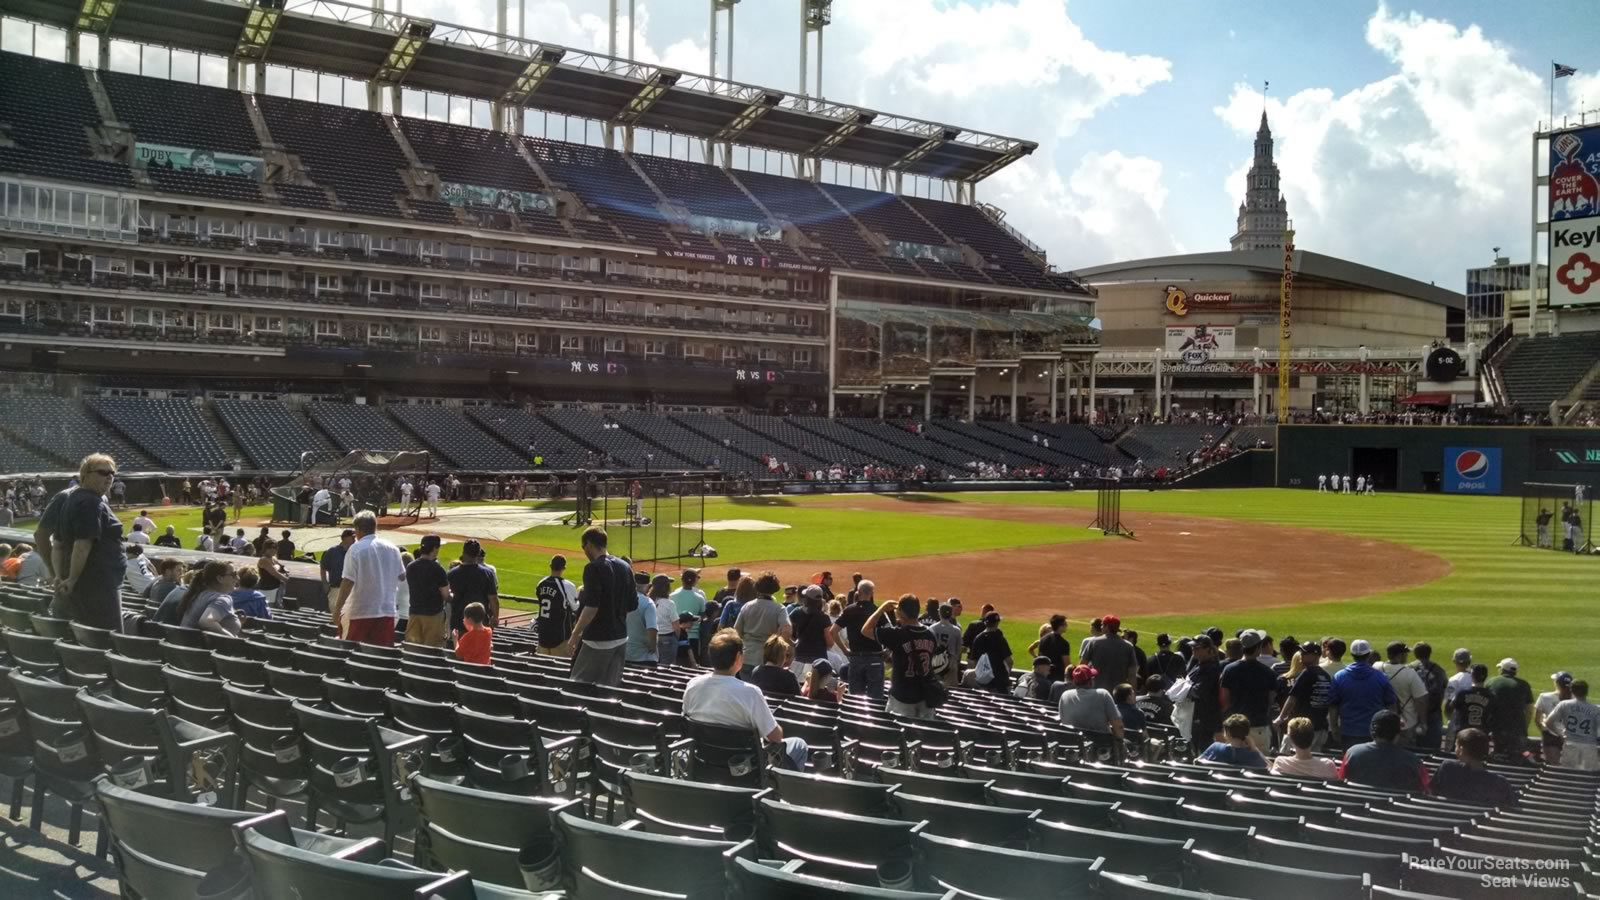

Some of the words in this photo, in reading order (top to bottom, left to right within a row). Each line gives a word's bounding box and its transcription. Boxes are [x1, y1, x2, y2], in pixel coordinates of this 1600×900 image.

[1555, 175, 1582, 184] COVER
[1555, 186, 1582, 196] EARTH
[1561, 182, 1577, 190] THE
[1554, 225, 1600, 248] Key
[1284, 244, 1295, 328] WALGREENS
[1194, 293, 1230, 302] Quicken
[1458, 481, 1486, 490] pepsi
[540, 586, 557, 597] JETER
[540, 598, 552, 618] 2
[1468, 704, 1483, 725] 2
[1567, 715, 1591, 735] 24
